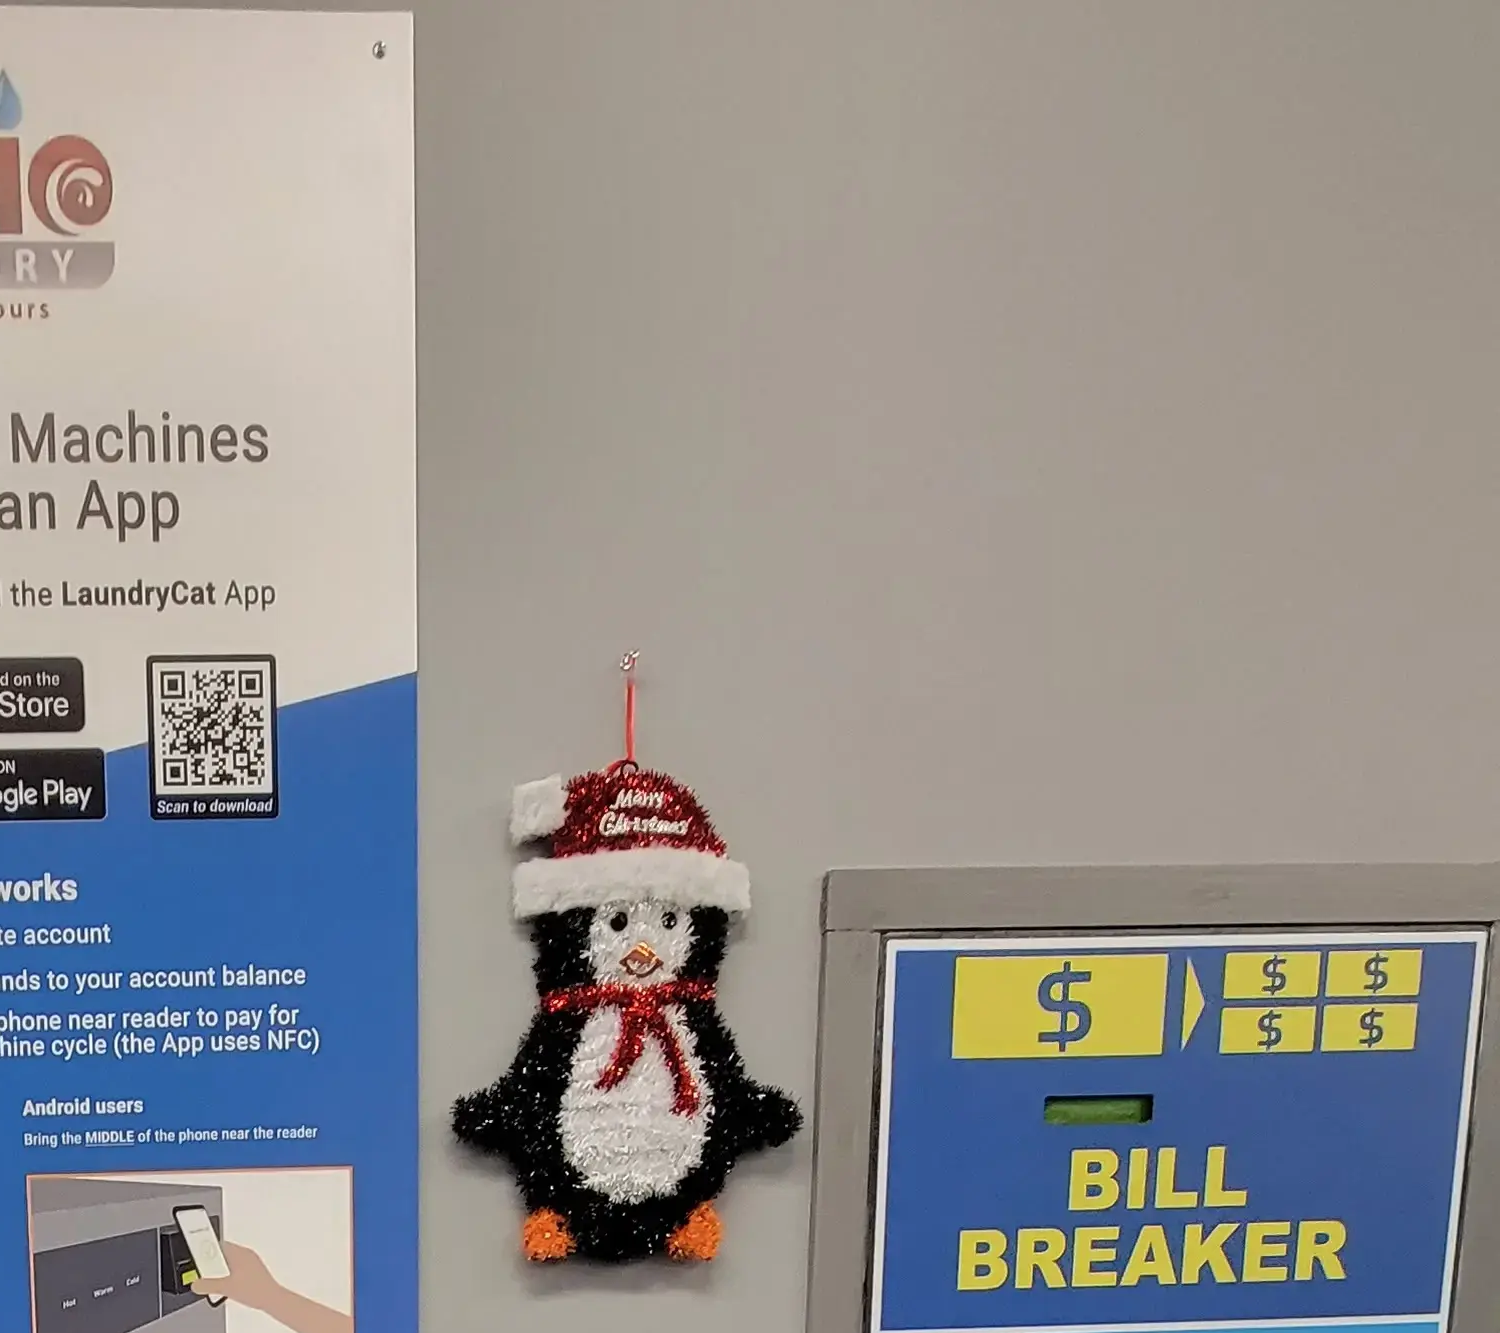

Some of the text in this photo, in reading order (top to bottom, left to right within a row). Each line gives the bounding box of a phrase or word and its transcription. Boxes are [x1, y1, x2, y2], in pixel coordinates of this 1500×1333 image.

[10, 409, 270, 464] Machines
[75, 479, 180, 543] App
[10, 579, 53, 608] the
[61, 578, 217, 613] LaundryCat
[224, 579, 277, 612] App
[13, 675, 33, 687] on
[36, 672, 61, 687] the
[42, 778, 93, 811] Play
[156, 797, 274, 815] Scan to download
[599, 810, 690, 837] Christmas
[23, 923, 112, 946] account
[46, 971, 69, 991] to
[75, 971, 123, 995] your
[129, 967, 216, 989] account
[221, 964, 307, 987] balance
[67, 1011, 116, 1032] near
[121, 1007, 191, 1030] reader
[196, 1007, 219, 1028] to
[224, 1007, 265, 1032] pay
[268, 1004, 300, 1026] for
[51, 1034, 108, 1060] cycle
[113, 1033, 156, 1059] (the
[161, 1033, 204, 1057] App
[210, 1031, 261, 1052] uses
[267, 1026, 320, 1055] NFC)
[22, 1097, 144, 1117] Android users
[24, 1125, 318, 1149] Bring the MIDDLE of the phone near the reader
[1067, 1144, 1249, 1213] BILL
[956, 1219, 1349, 1292] BREAKER
